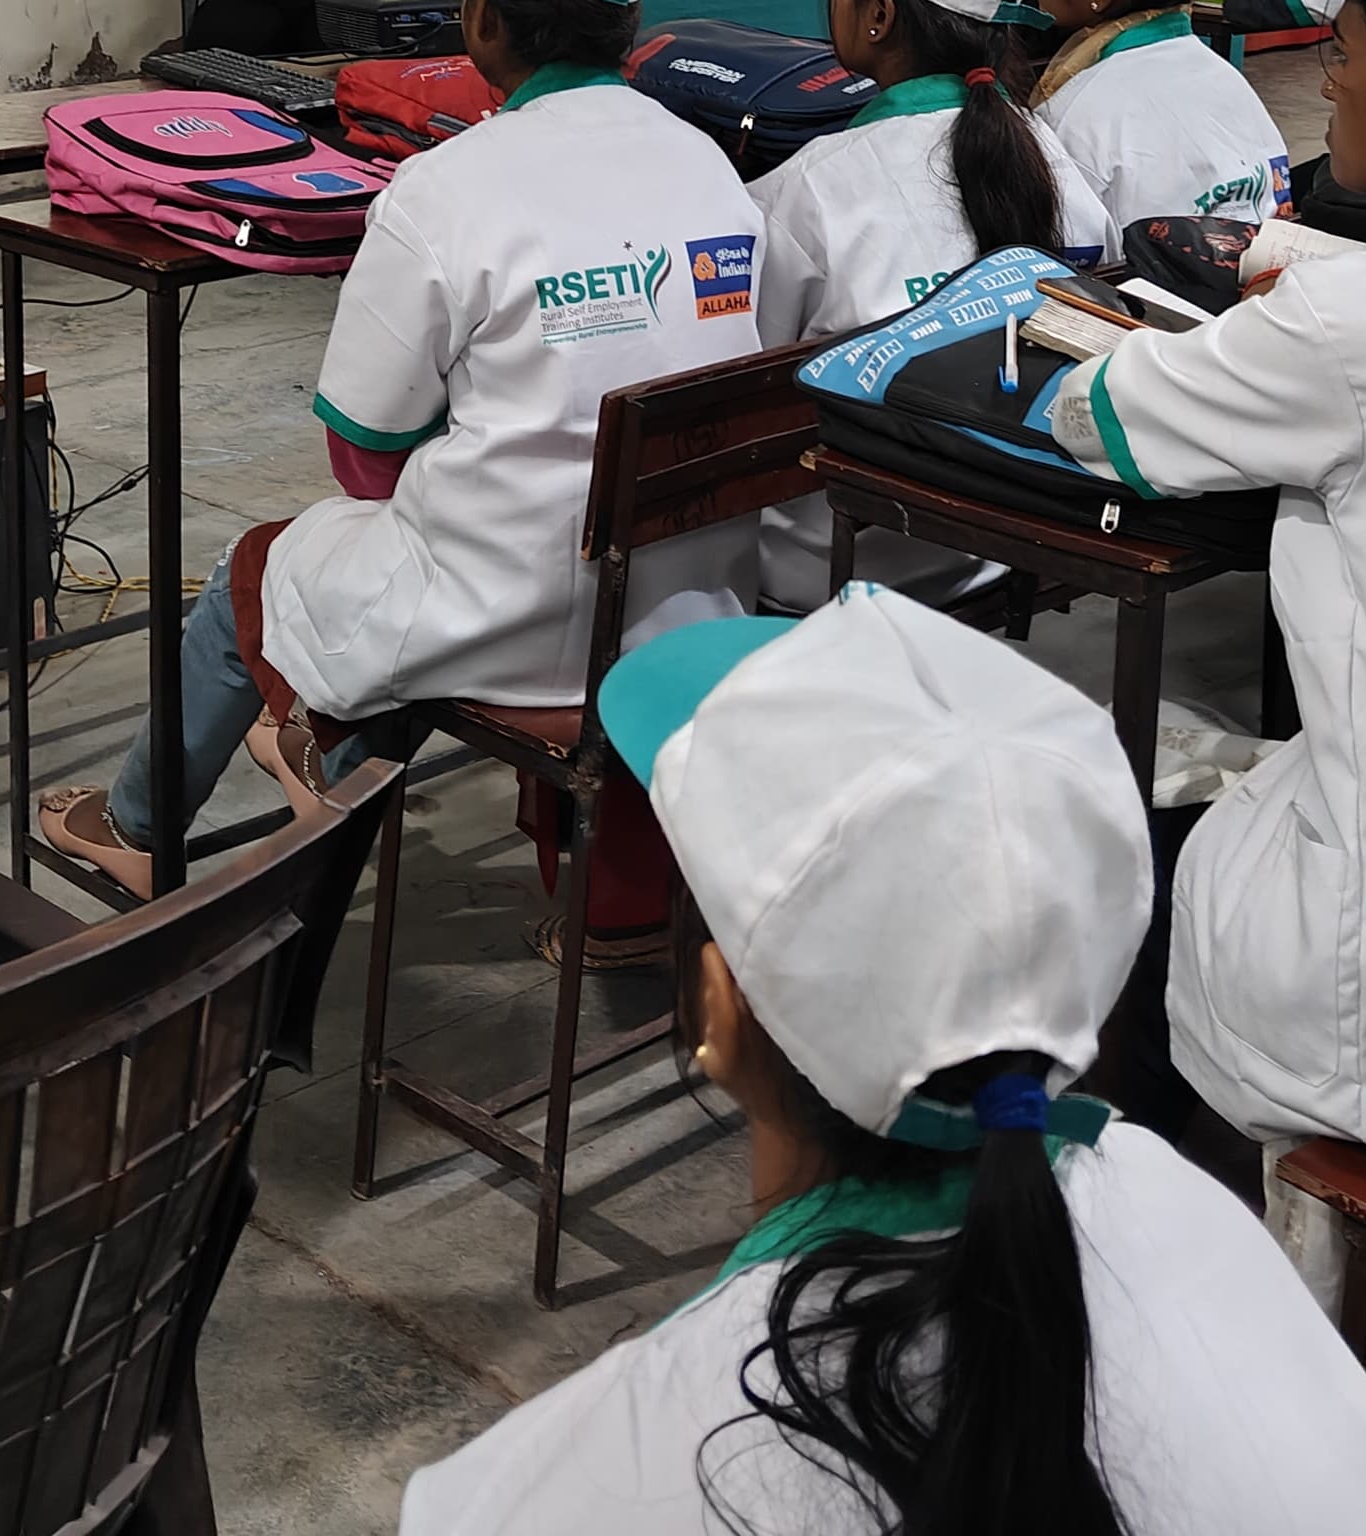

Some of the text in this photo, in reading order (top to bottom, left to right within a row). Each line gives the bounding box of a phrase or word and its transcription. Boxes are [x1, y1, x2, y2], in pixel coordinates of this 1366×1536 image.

[535, 263, 641, 309] RSETI
[540, 298, 643, 322] Rural Self Employment
[541, 312, 624, 333] Training Institutes
[951, 299, 997, 325] NIKE
